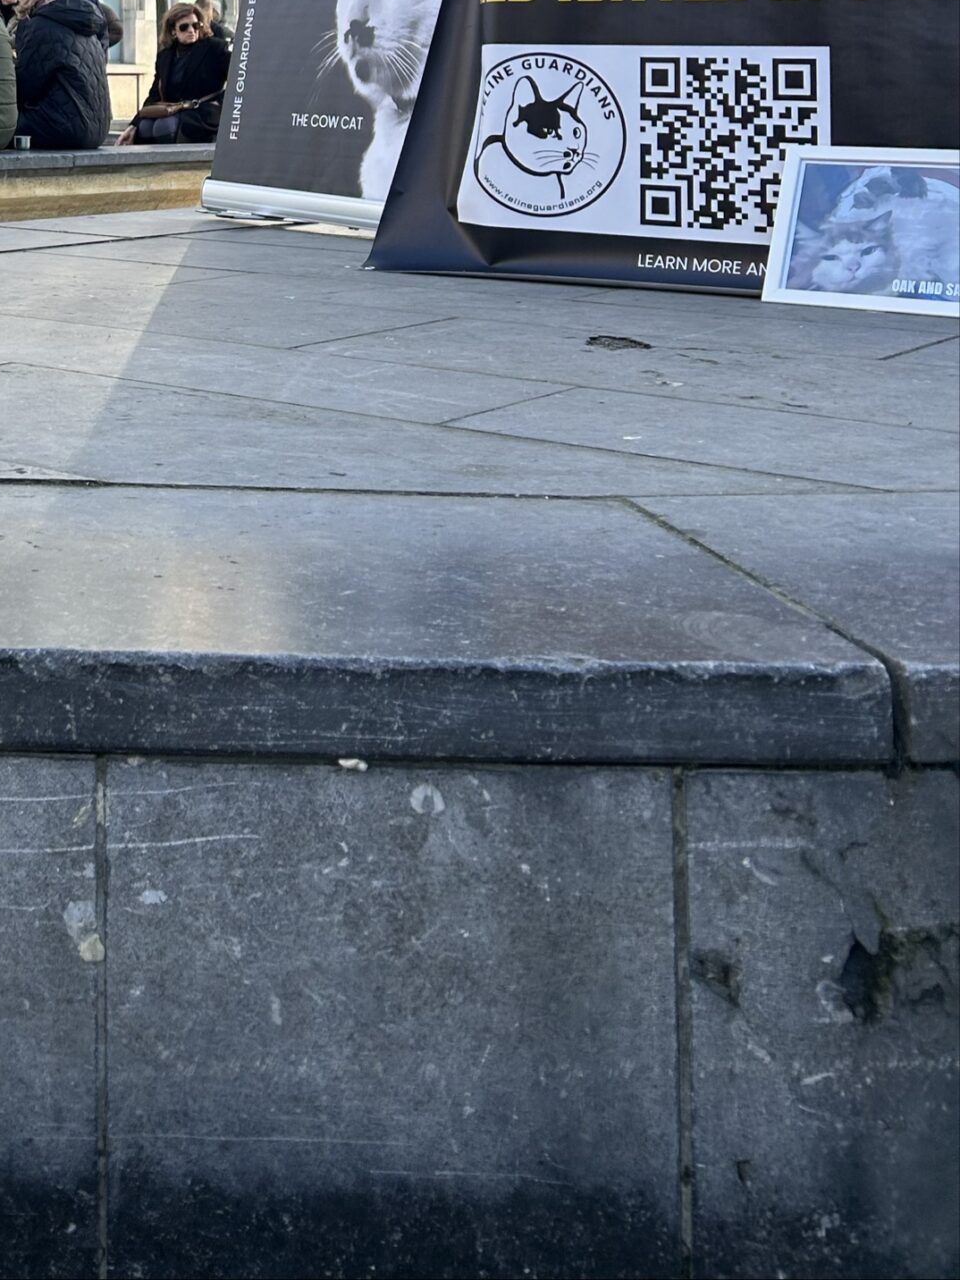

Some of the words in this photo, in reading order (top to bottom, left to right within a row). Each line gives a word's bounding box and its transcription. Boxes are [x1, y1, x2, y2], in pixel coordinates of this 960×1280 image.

[236, 7, 255, 94] GUARDIANS
[521, 58, 616, 120] GUARDIANS
[230, 95, 243, 140] FELINE
[291, 113, 309, 127] THE
[310, 114, 339, 129] COW
[340, 116, 363, 130] CAT
[637, 253, 688, 270] LEARN
[692, 257, 742, 275] MORE
[892, 279, 916, 294] OAK
[918, 280, 943, 295] AND
